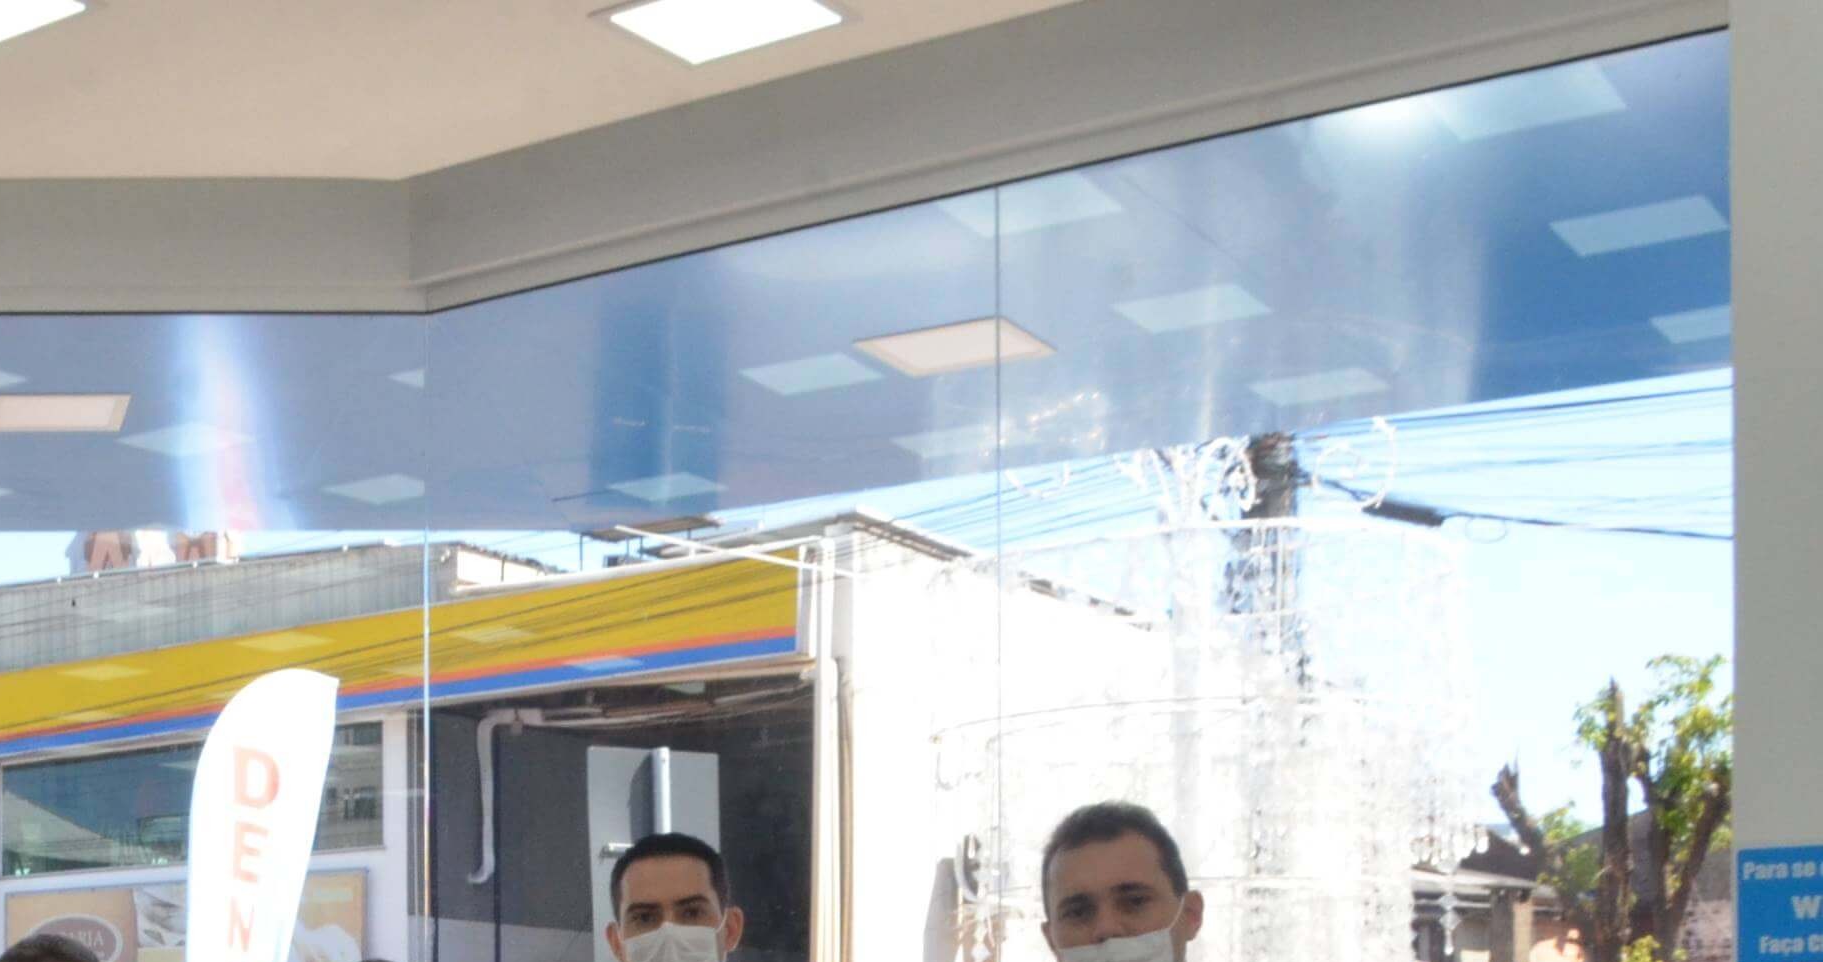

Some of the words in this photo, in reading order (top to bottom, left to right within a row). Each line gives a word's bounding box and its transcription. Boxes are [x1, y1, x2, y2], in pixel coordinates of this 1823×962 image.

[1742, 861, 1790, 880] Para
[1792, 861, 1817, 878] se
[1759, 935, 1805, 956] Faça
